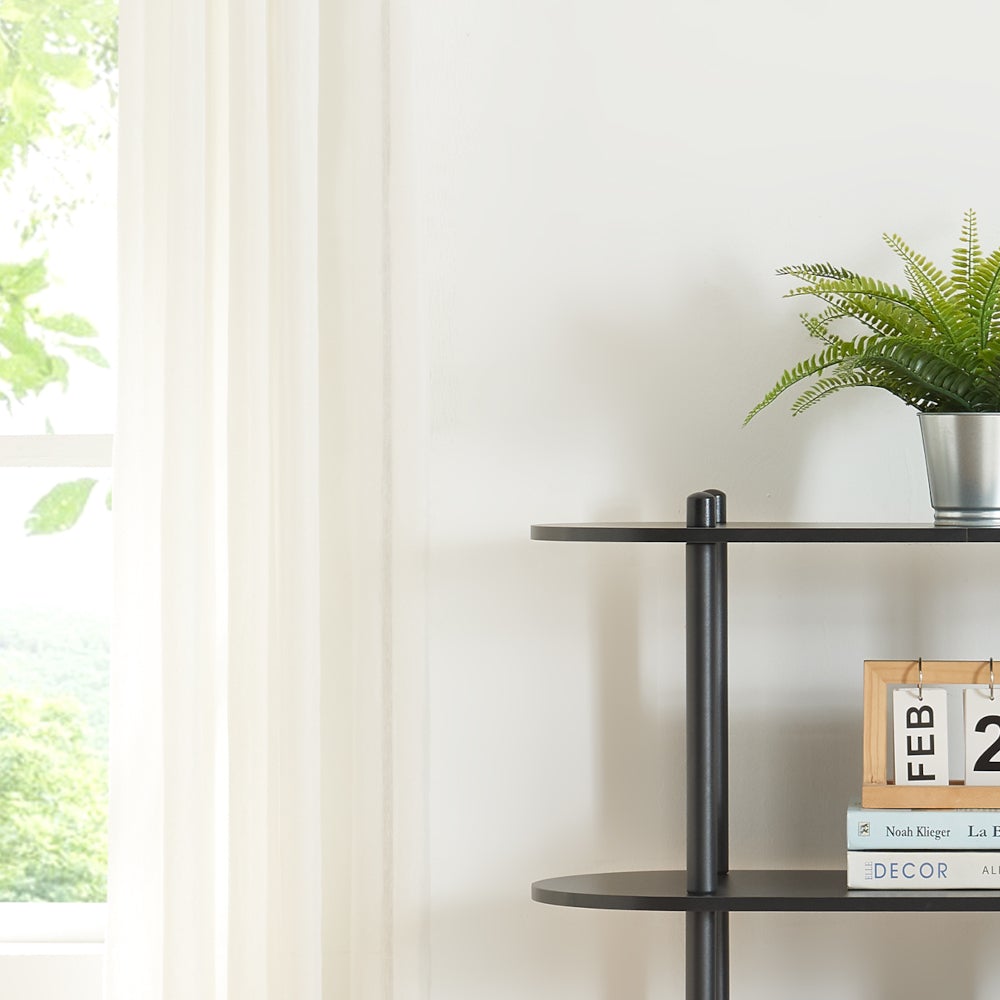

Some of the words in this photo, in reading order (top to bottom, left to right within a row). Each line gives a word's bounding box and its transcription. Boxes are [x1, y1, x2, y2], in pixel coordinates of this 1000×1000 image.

[906, 705, 936, 781] FEB
[886, 825, 914, 838] Noah
[916, 825, 951, 841] Klieger
[967, 825, 987, 838] La
[864, 861, 873, 880] ELLE
[874, 862, 948, 879] DECOR
